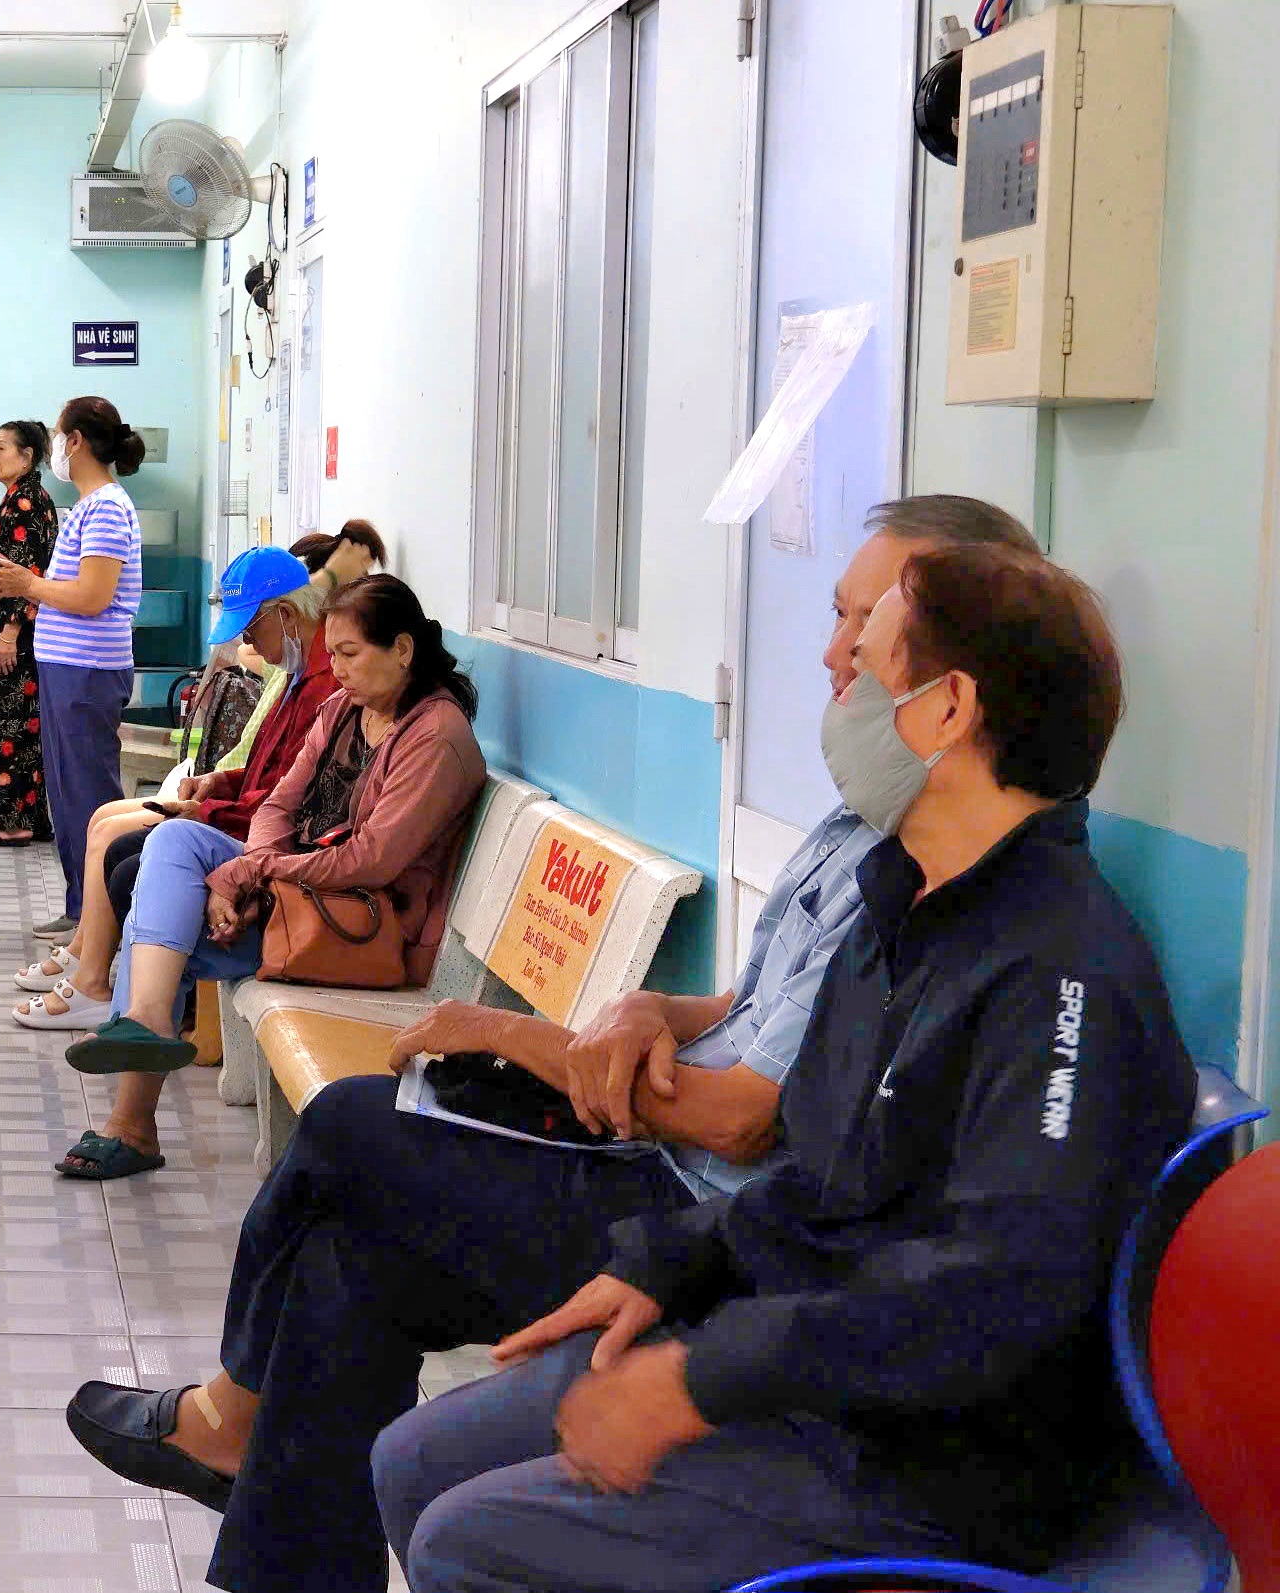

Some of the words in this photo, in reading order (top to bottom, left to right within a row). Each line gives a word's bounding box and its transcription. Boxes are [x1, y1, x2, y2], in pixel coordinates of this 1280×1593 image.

[77, 326, 96, 344] NHÀ
[98, 326, 111, 346] VỆ
[112, 330, 135, 344] SINH
[541, 838, 609, 916] Yakult
[1053, 978, 1084, 1062] SPORT
[1040, 1068, 1077, 1140] WEAR
